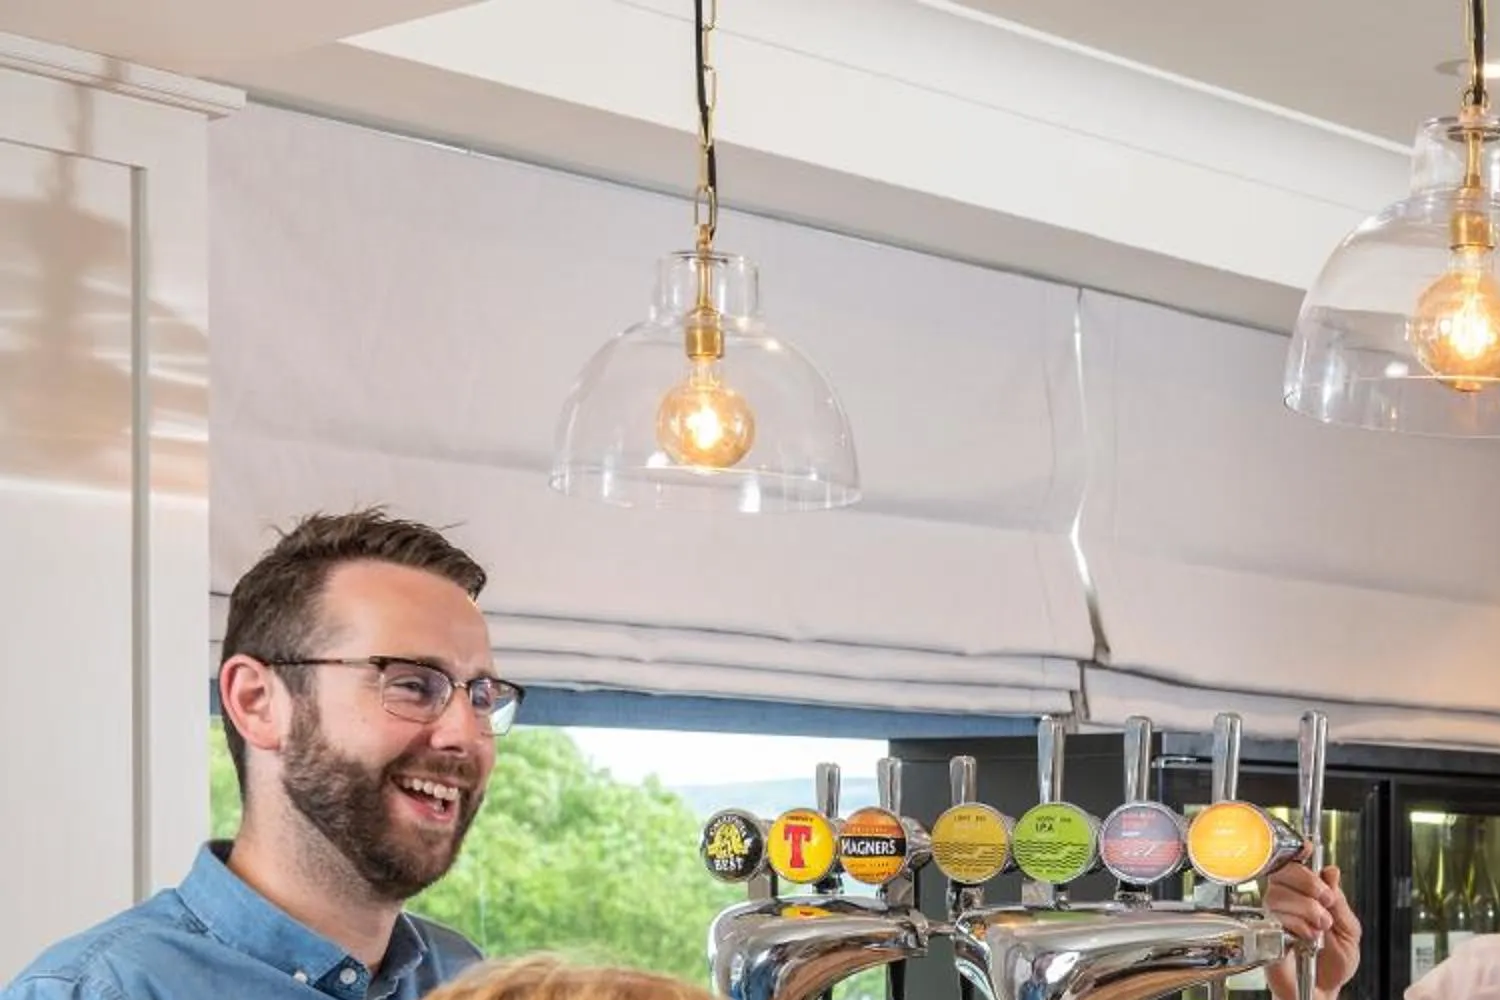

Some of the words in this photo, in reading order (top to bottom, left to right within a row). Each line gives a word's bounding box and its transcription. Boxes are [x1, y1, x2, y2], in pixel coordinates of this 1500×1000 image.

[783, 824, 812, 868] T
[841, 838, 897, 855] MAGNERS
[713, 855, 745, 871] BEST
